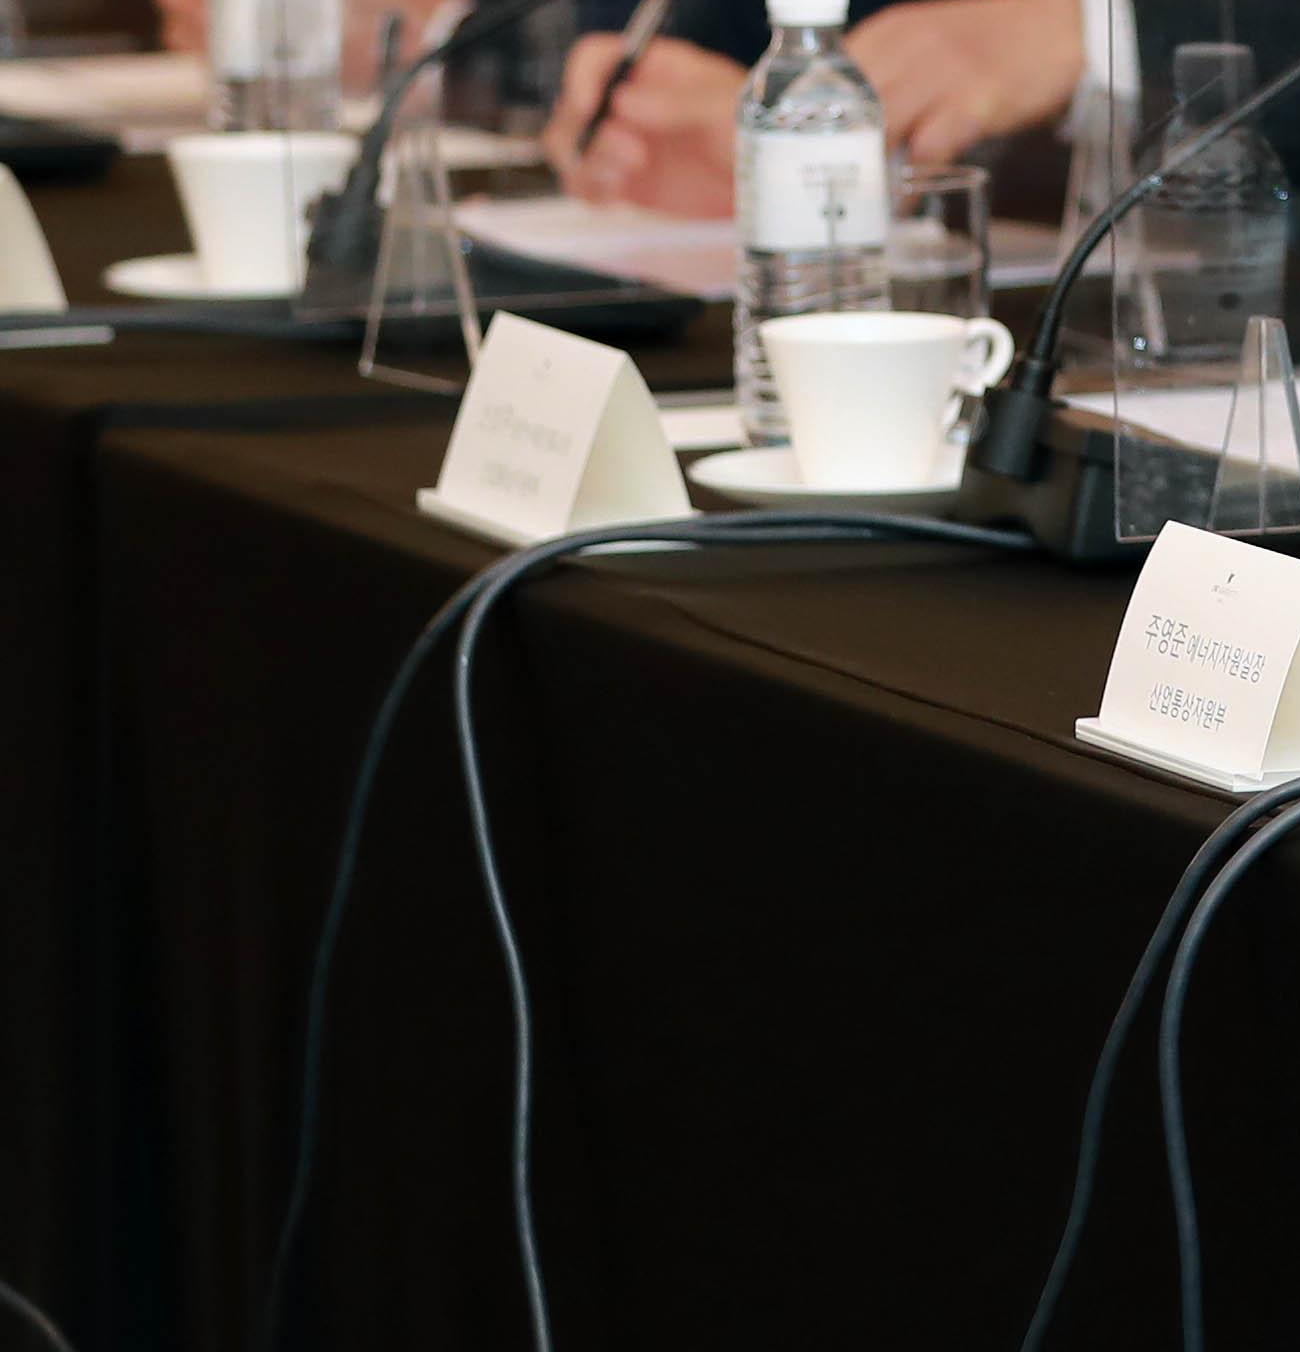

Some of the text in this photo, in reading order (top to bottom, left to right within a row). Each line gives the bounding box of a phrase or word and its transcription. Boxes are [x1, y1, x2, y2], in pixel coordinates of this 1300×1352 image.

[1145, 614, 1266, 683] 주영준 에너지자원실장
[1149, 683, 1226, 732] 산업통상자원부
